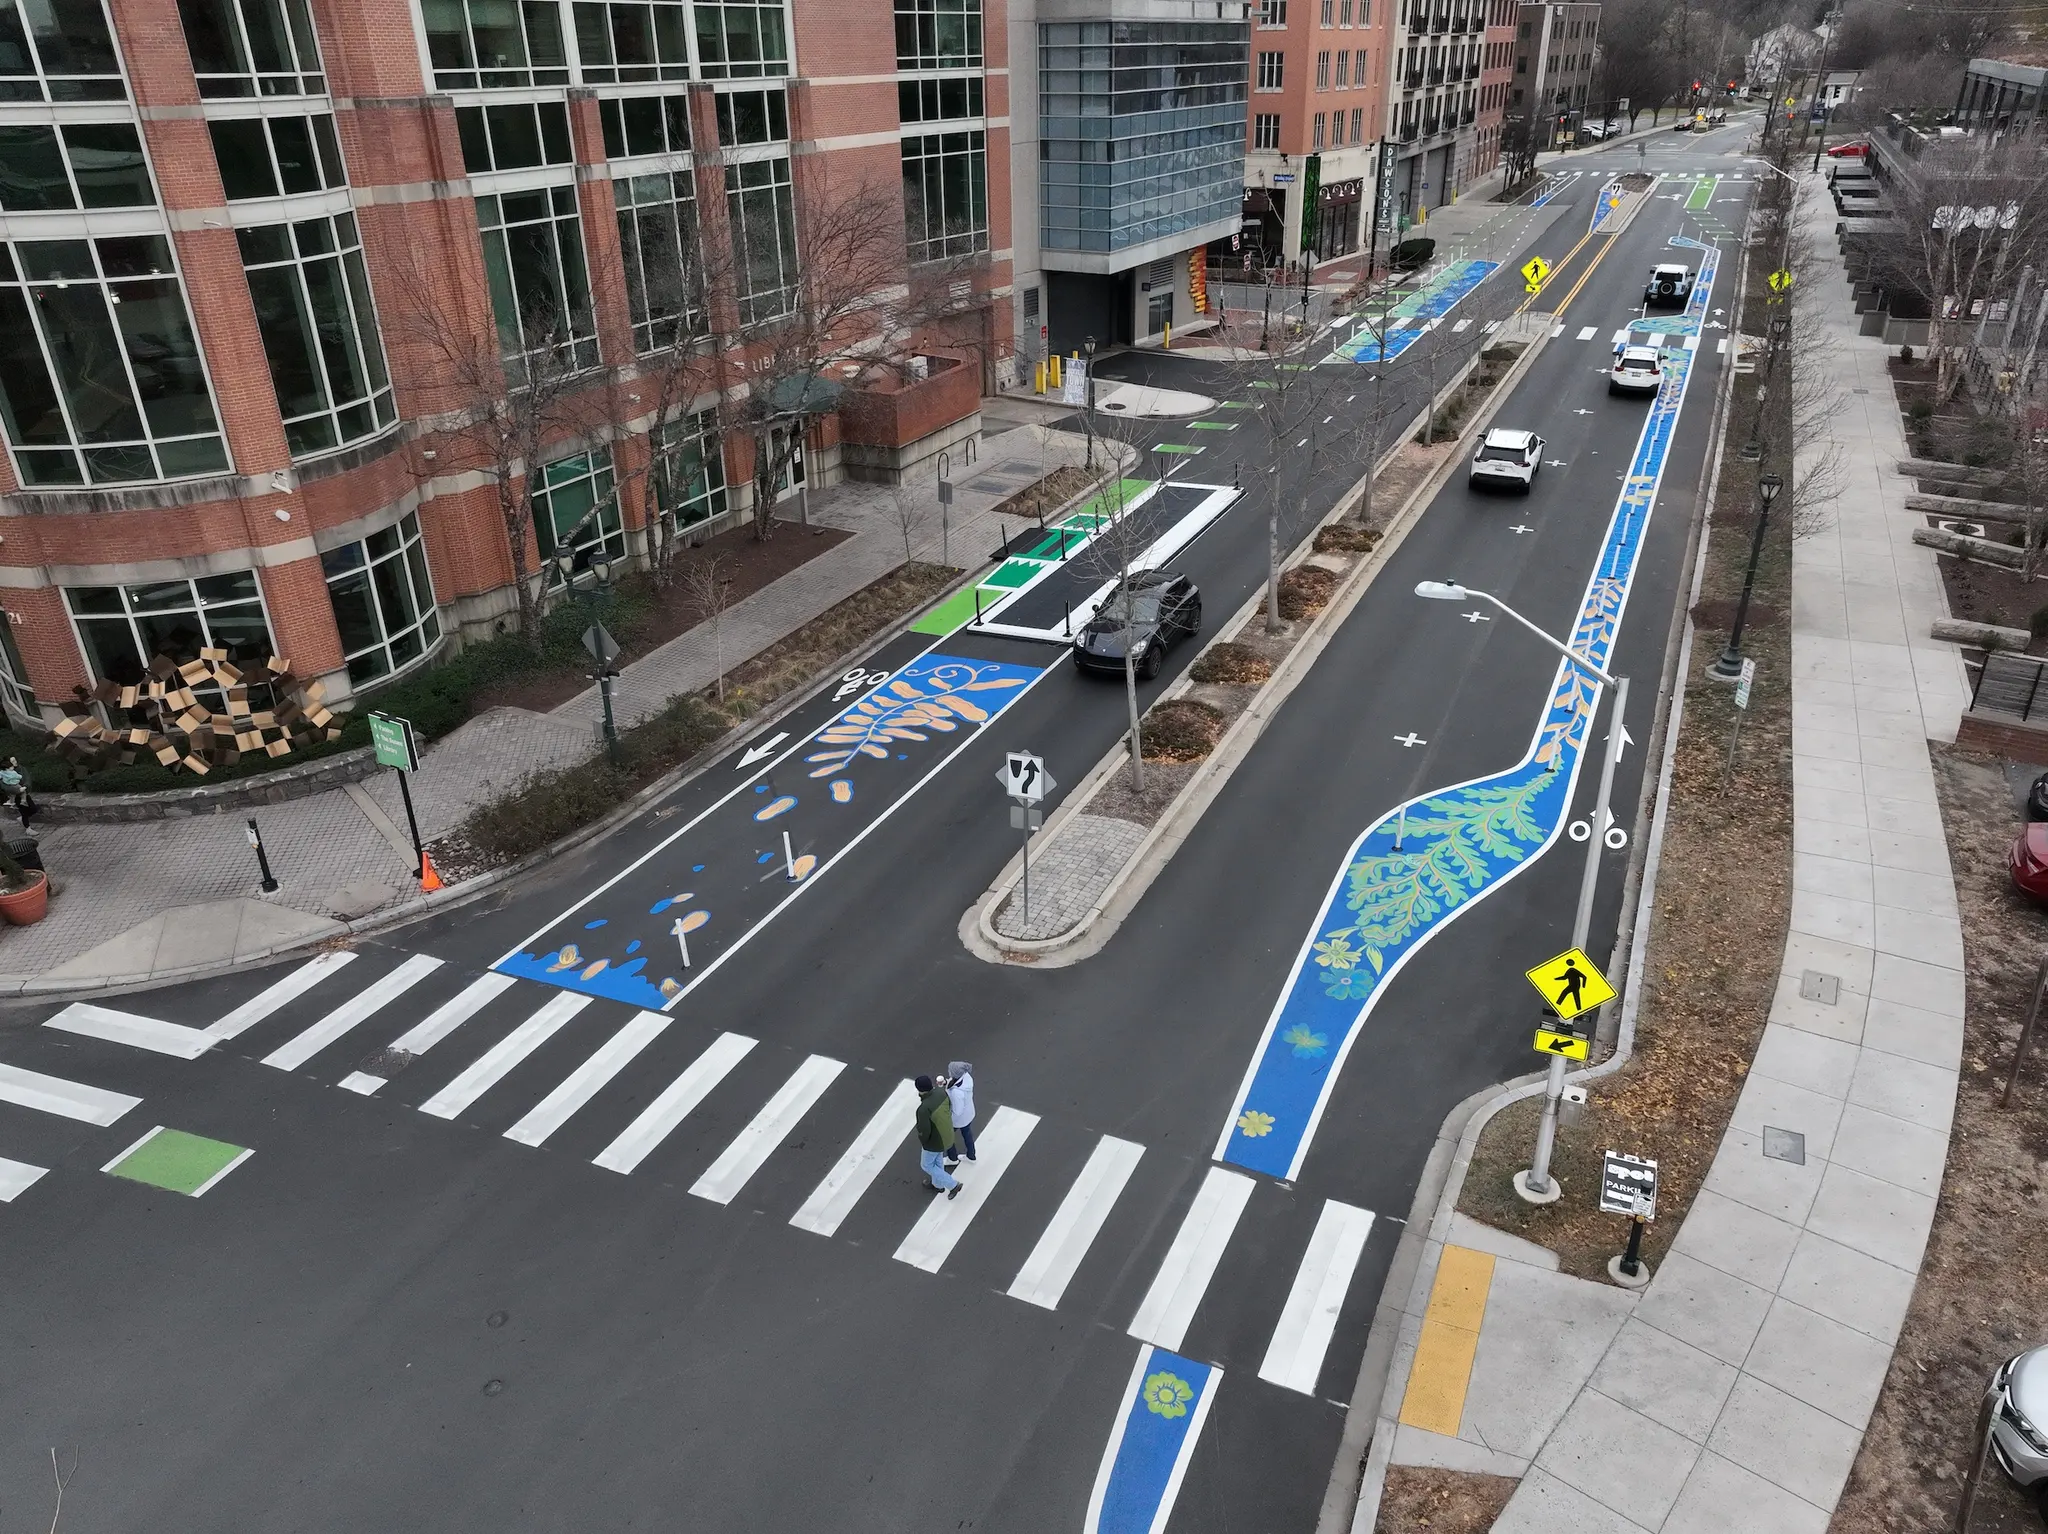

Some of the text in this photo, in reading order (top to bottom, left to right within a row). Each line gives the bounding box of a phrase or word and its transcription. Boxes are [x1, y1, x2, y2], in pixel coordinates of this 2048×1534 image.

[8, 612, 22, 625] 21
[1607, 1163, 1654, 1182] spot
[1606, 1180, 1653, 1195] PARKI
